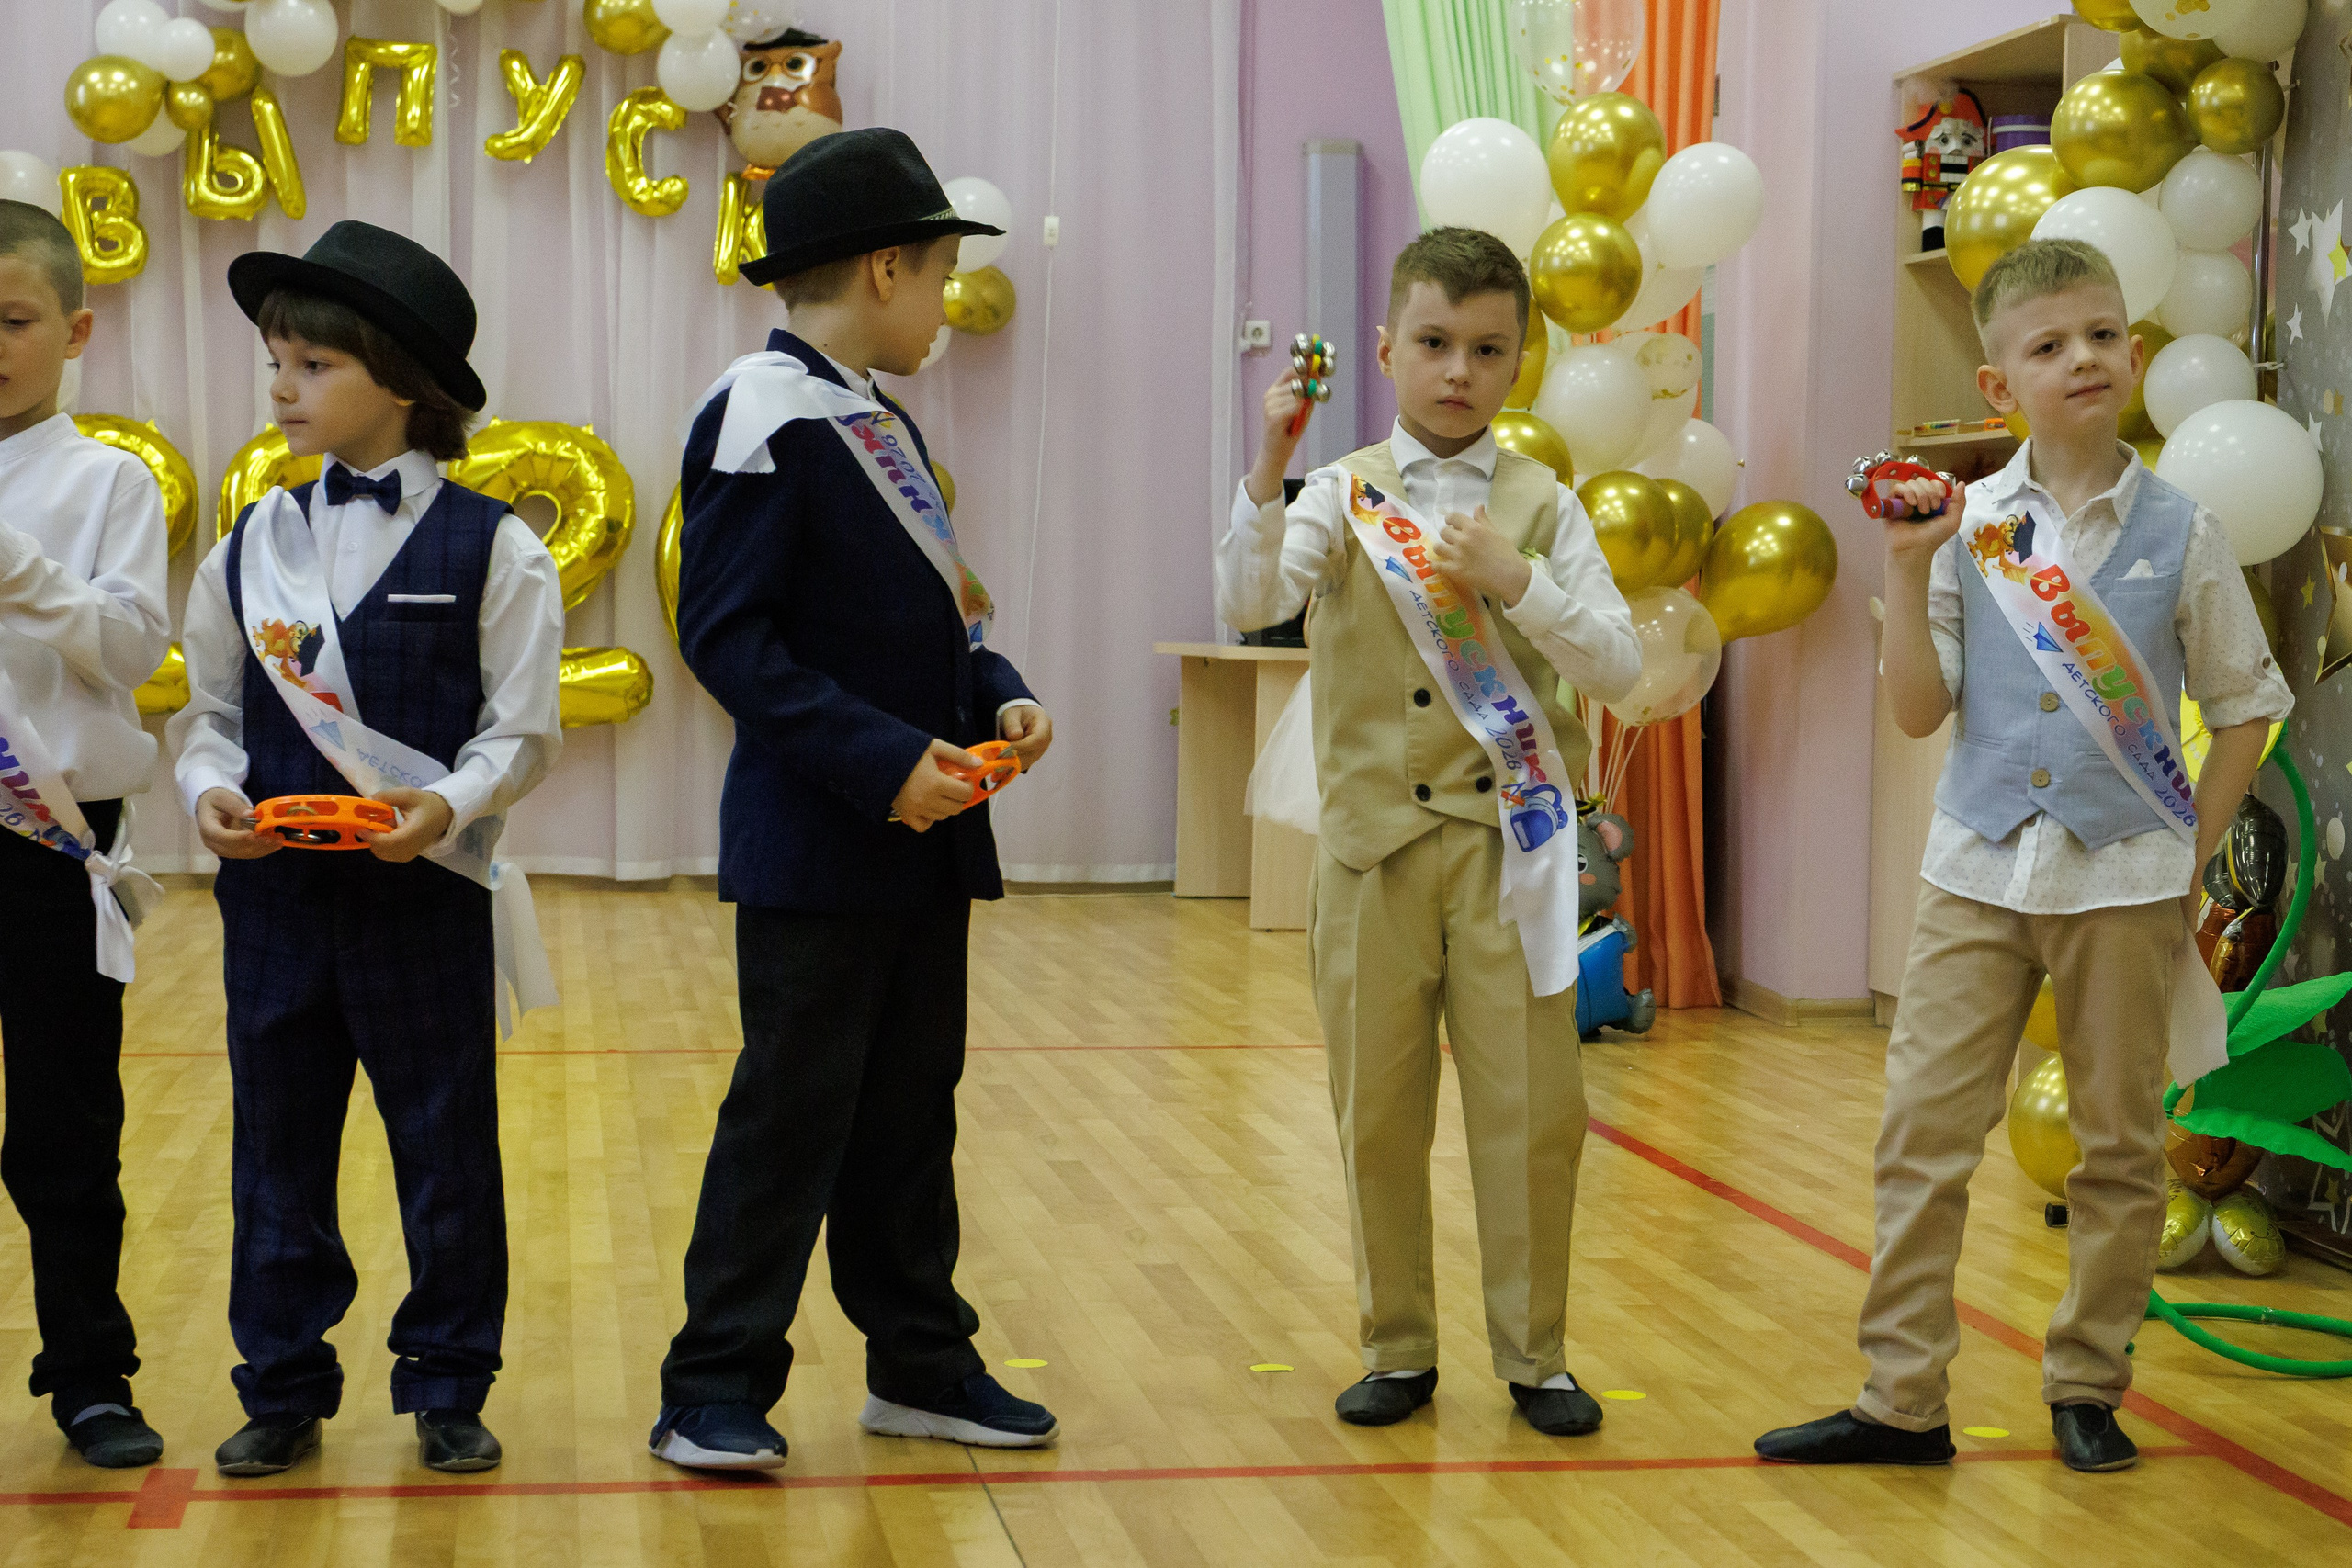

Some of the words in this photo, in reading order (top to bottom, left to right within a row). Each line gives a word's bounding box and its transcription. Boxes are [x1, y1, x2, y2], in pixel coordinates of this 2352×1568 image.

[1408, 589, 1459, 671] ДЕТСКОГО
[1458, 681, 1488, 720] САДА
[1484, 726, 1521, 771] 2026
[2030, 563, 2197, 812] Выпускни
[2062, 661, 2127, 736] ДЕТСКОГО
[2127, 743, 2155, 781] САДА
[2154, 785, 2197, 827] 2026
